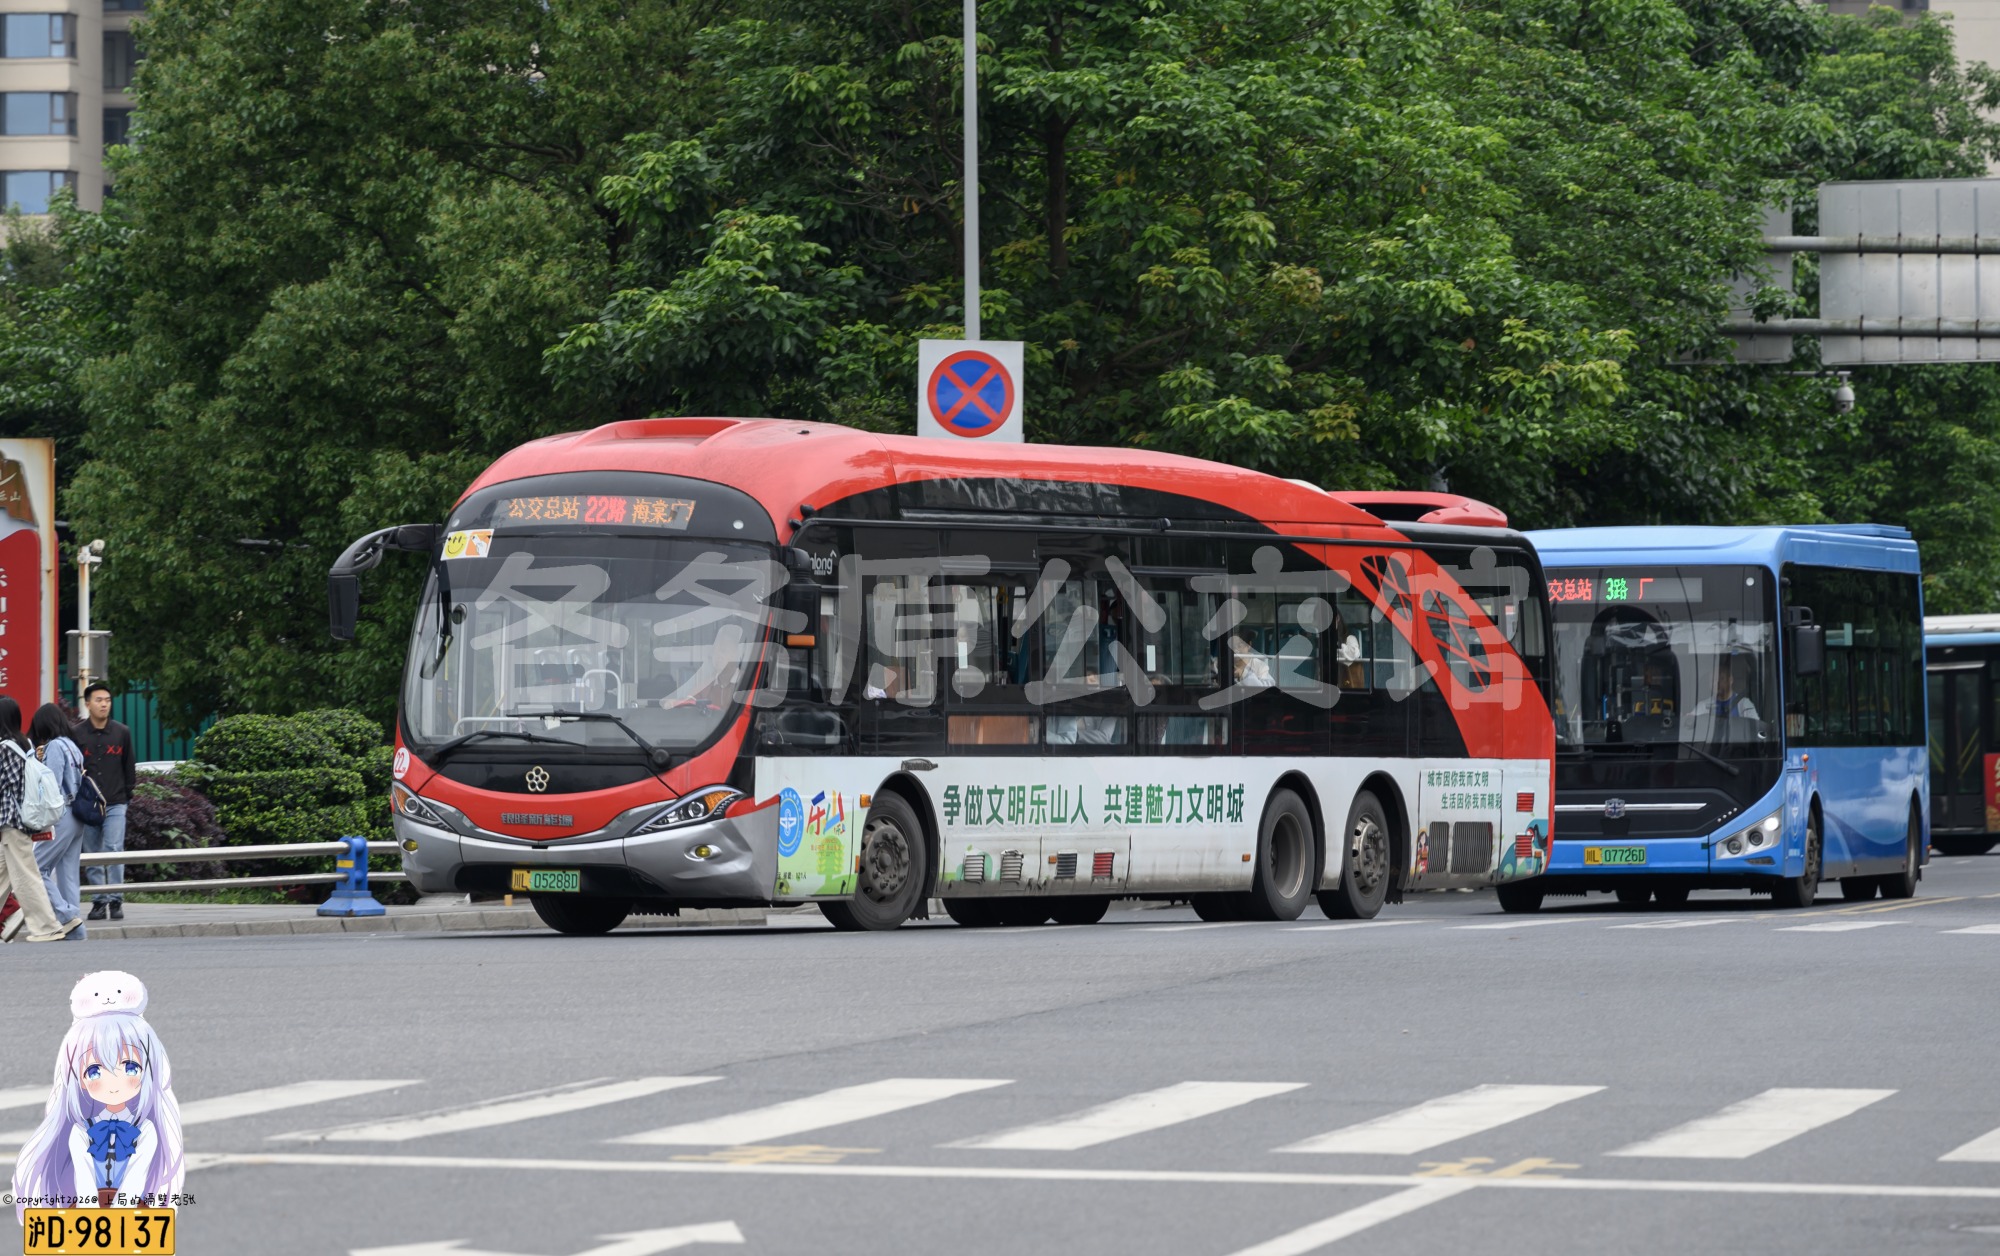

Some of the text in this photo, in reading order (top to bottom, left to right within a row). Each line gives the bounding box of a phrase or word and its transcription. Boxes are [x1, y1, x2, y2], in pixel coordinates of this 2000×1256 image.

[508, 496, 580, 520] 公交总站
[584, 495, 627, 523] 22路
[1548, 578, 1592, 601] 交总站
[1606, 578, 1628, 600] 3路
[1428, 771, 1489, 787] 城市因你我而文明
[806, 790, 845, 835] 乐山
[943, 783, 1245, 825] 争做文明乐山人 共建魅力文明城
[1441, 793, 1502, 810] 生活因你我而精彩
